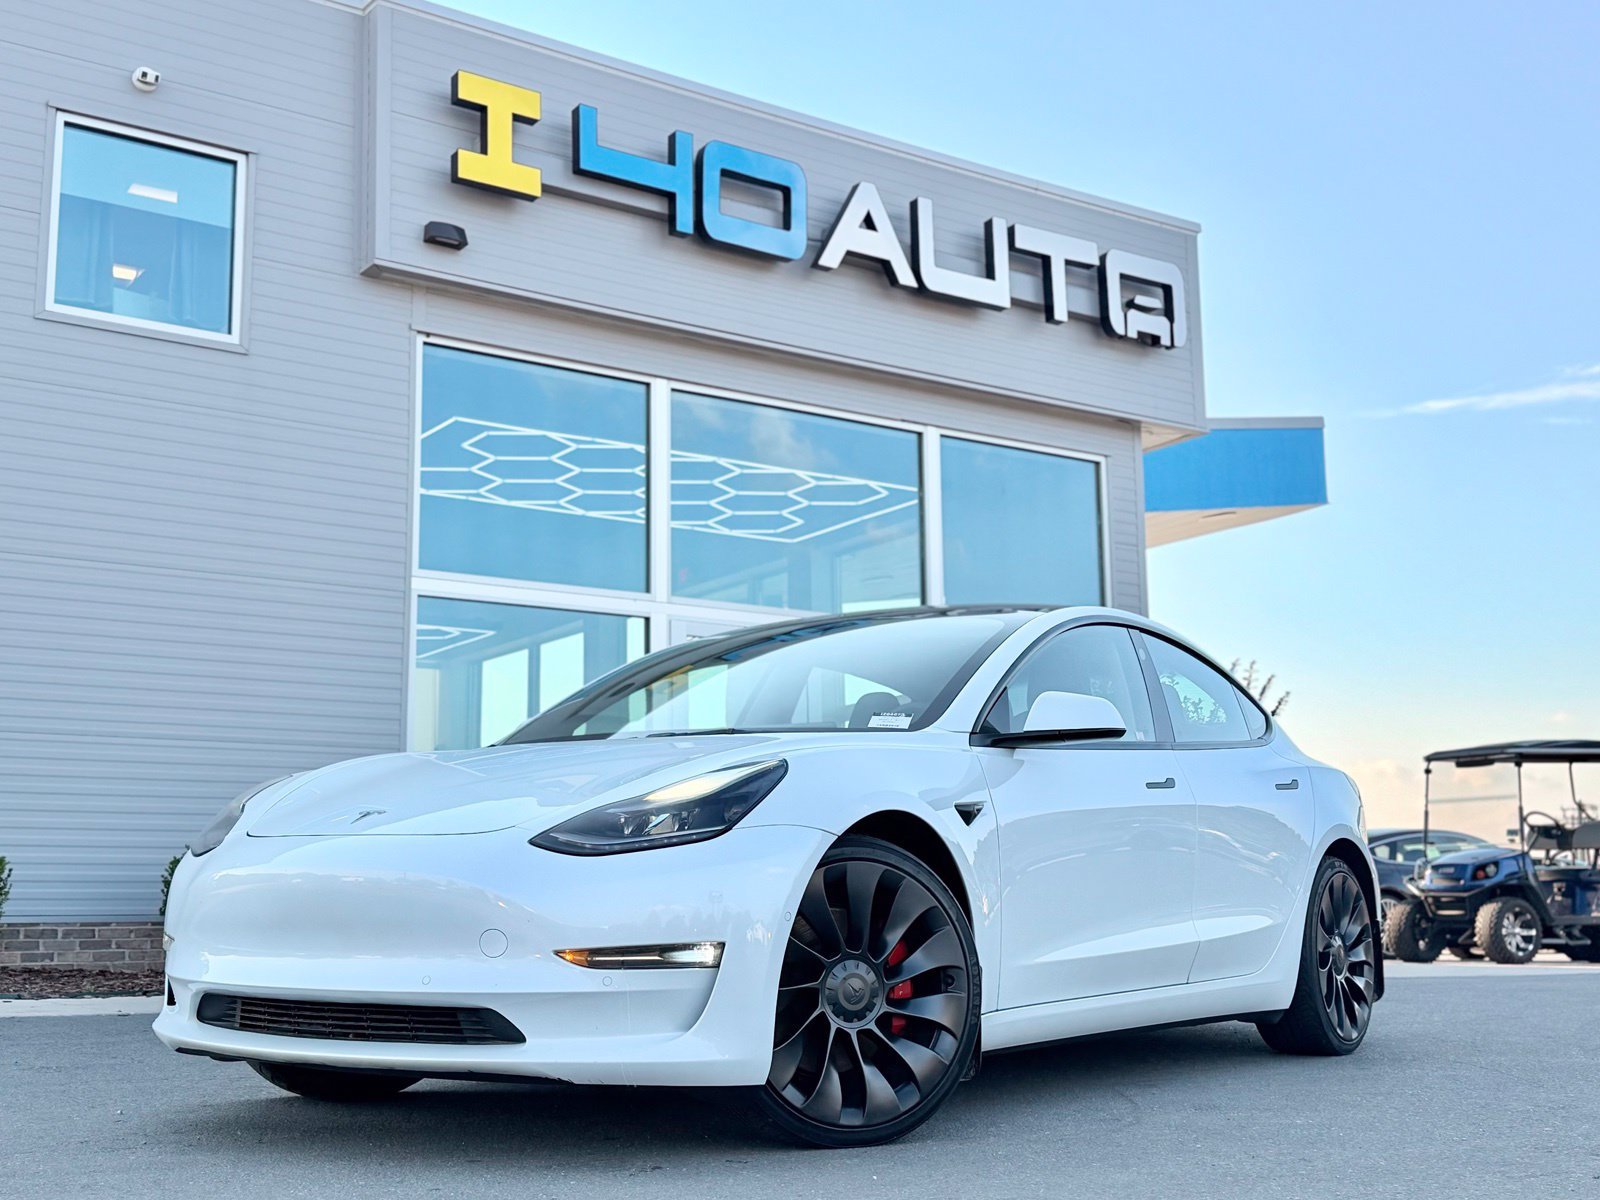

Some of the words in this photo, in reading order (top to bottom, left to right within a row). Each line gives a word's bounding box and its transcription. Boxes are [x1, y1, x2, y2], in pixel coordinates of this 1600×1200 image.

[451, 69, 542, 200] I
[572, 103, 808, 263] 40
[812, 181, 1188, 350] AUTO
[969, 956, 980, 1024] ADVANTA
